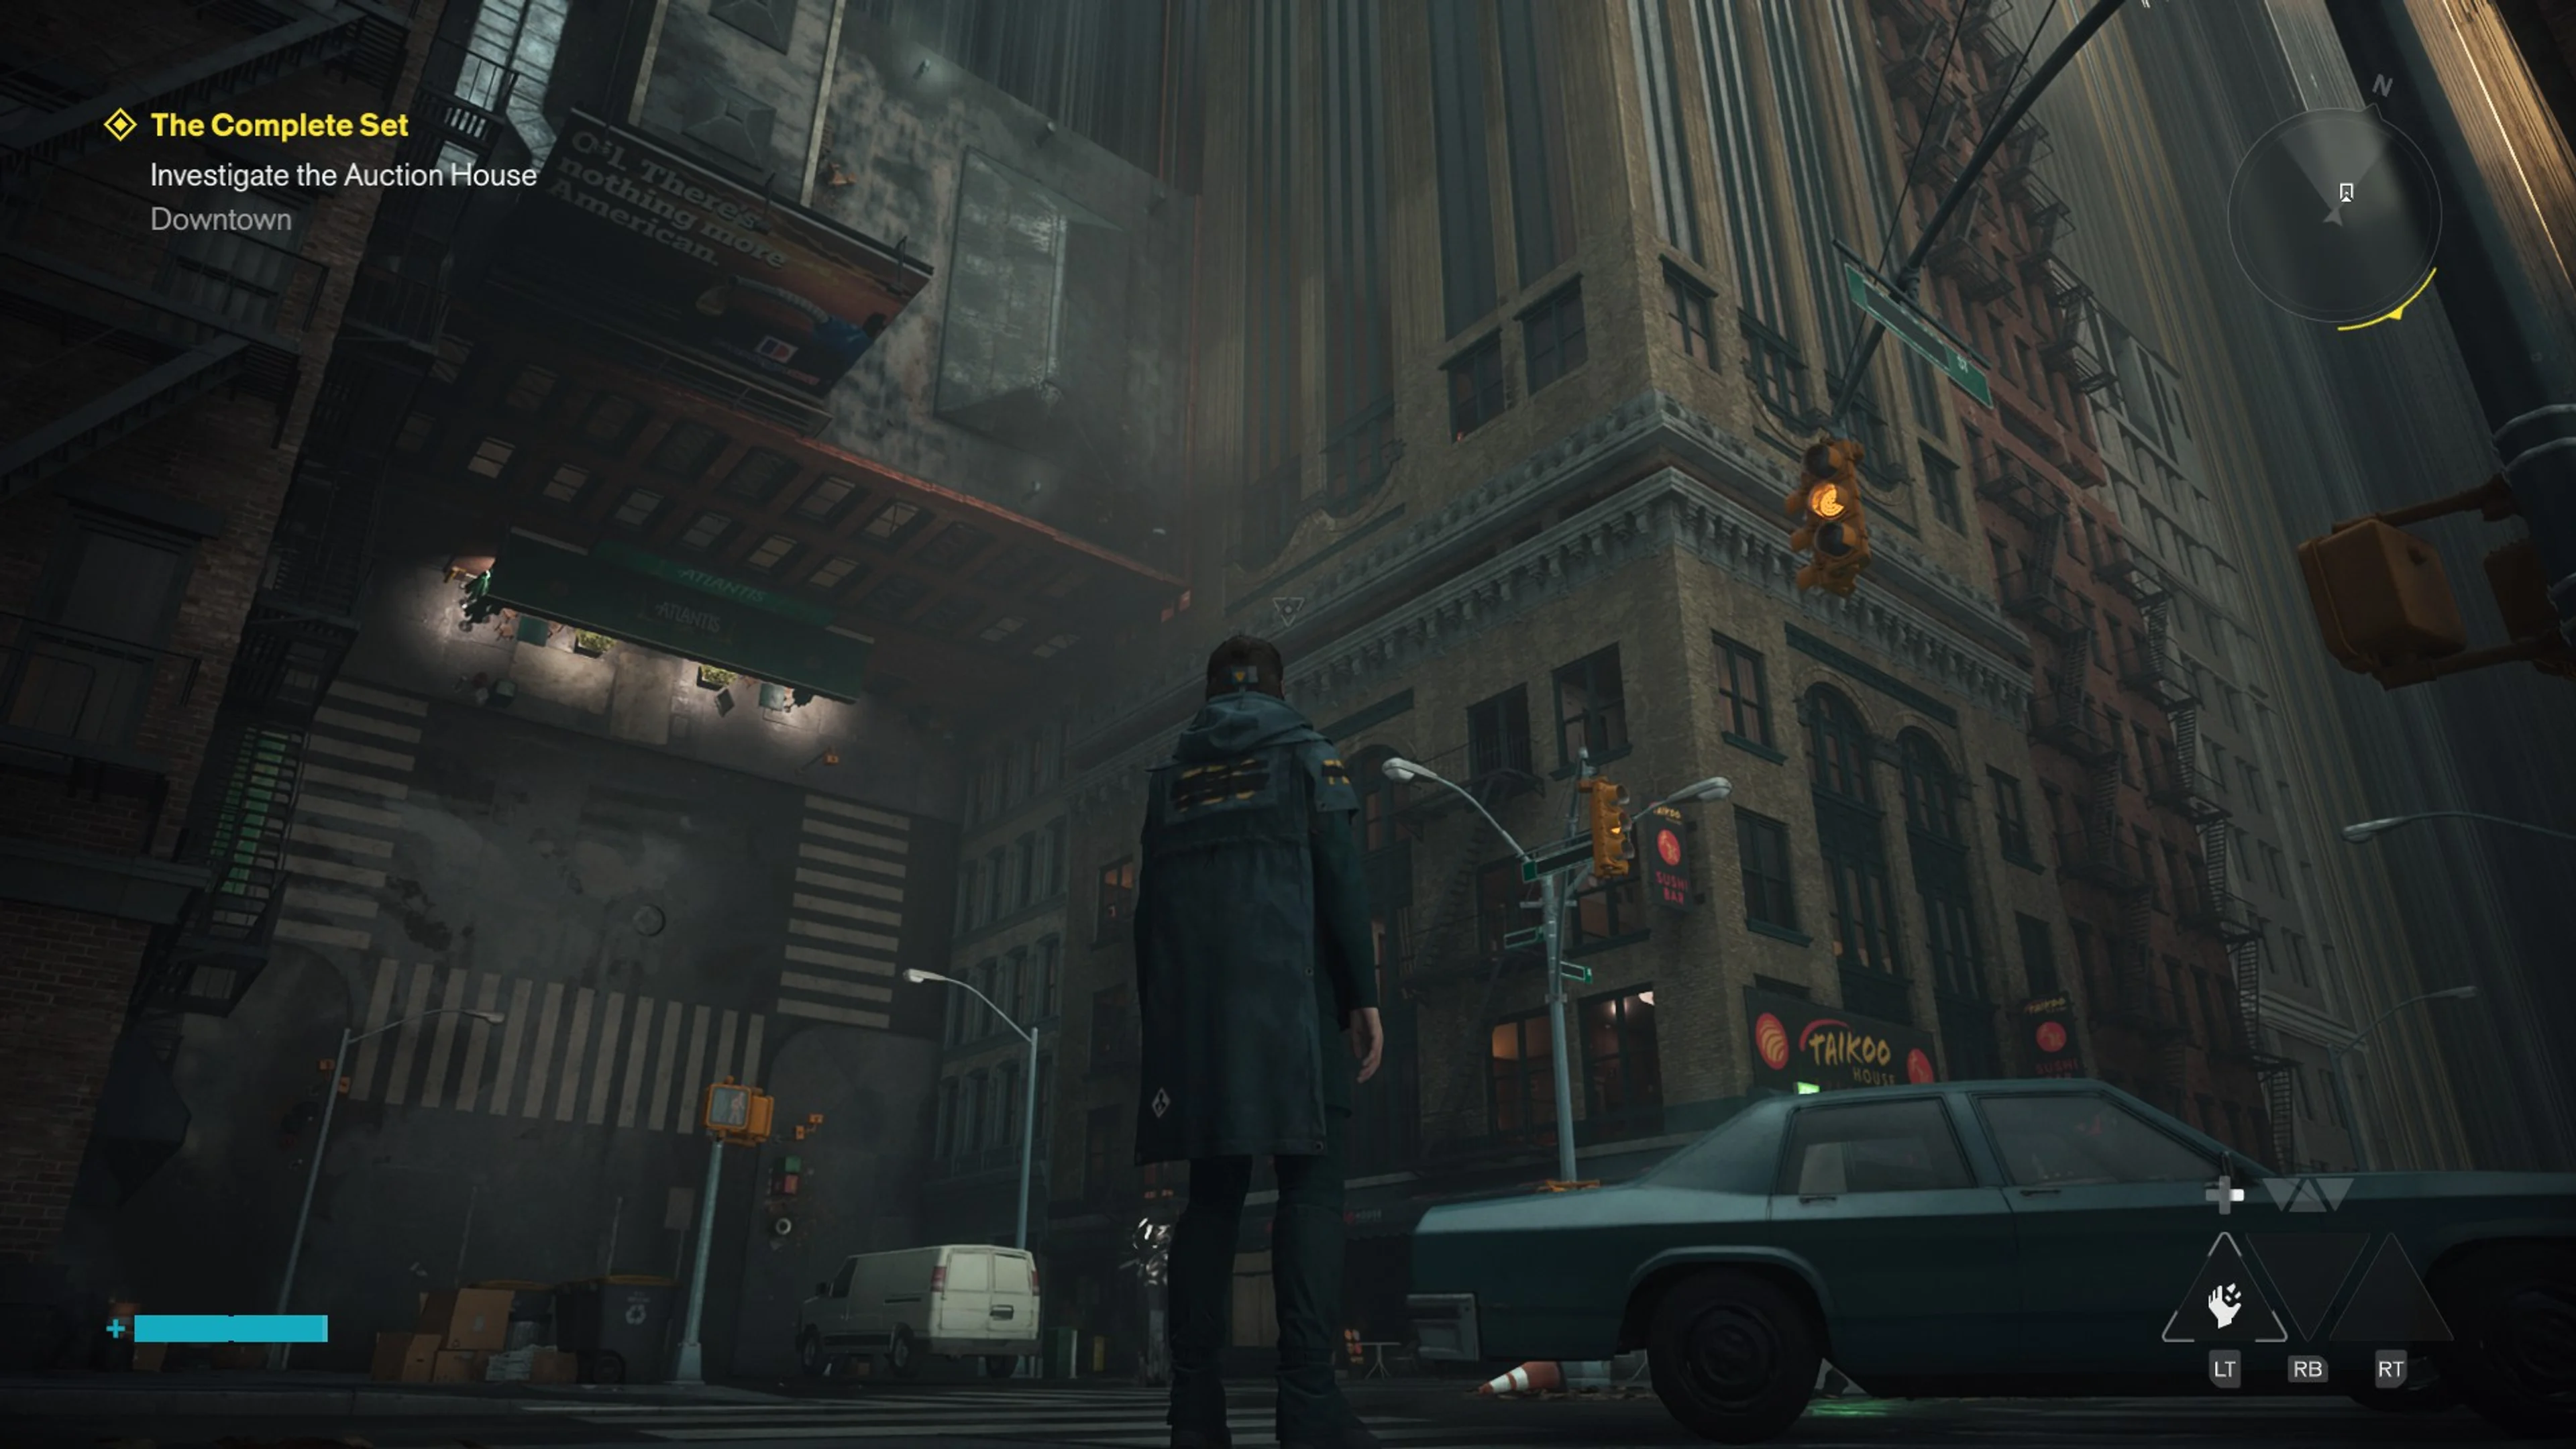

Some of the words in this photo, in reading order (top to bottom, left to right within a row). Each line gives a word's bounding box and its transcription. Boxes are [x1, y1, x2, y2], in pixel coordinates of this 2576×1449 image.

[641, 158, 761, 228] There's
[546, 179, 719, 266] American.
[557, 156, 698, 231] nothing
[700, 223, 788, 268] more
[678, 569, 767, 602] ATLANTIS
[655, 601, 721, 634] ATLANTIS
[1656, 870, 1688, 892] SUSHI
[1663, 887, 1684, 905] BAR
[1809, 1030, 1891, 1067] TAIKOO
[1853, 1067, 1896, 1085] HOUSE
